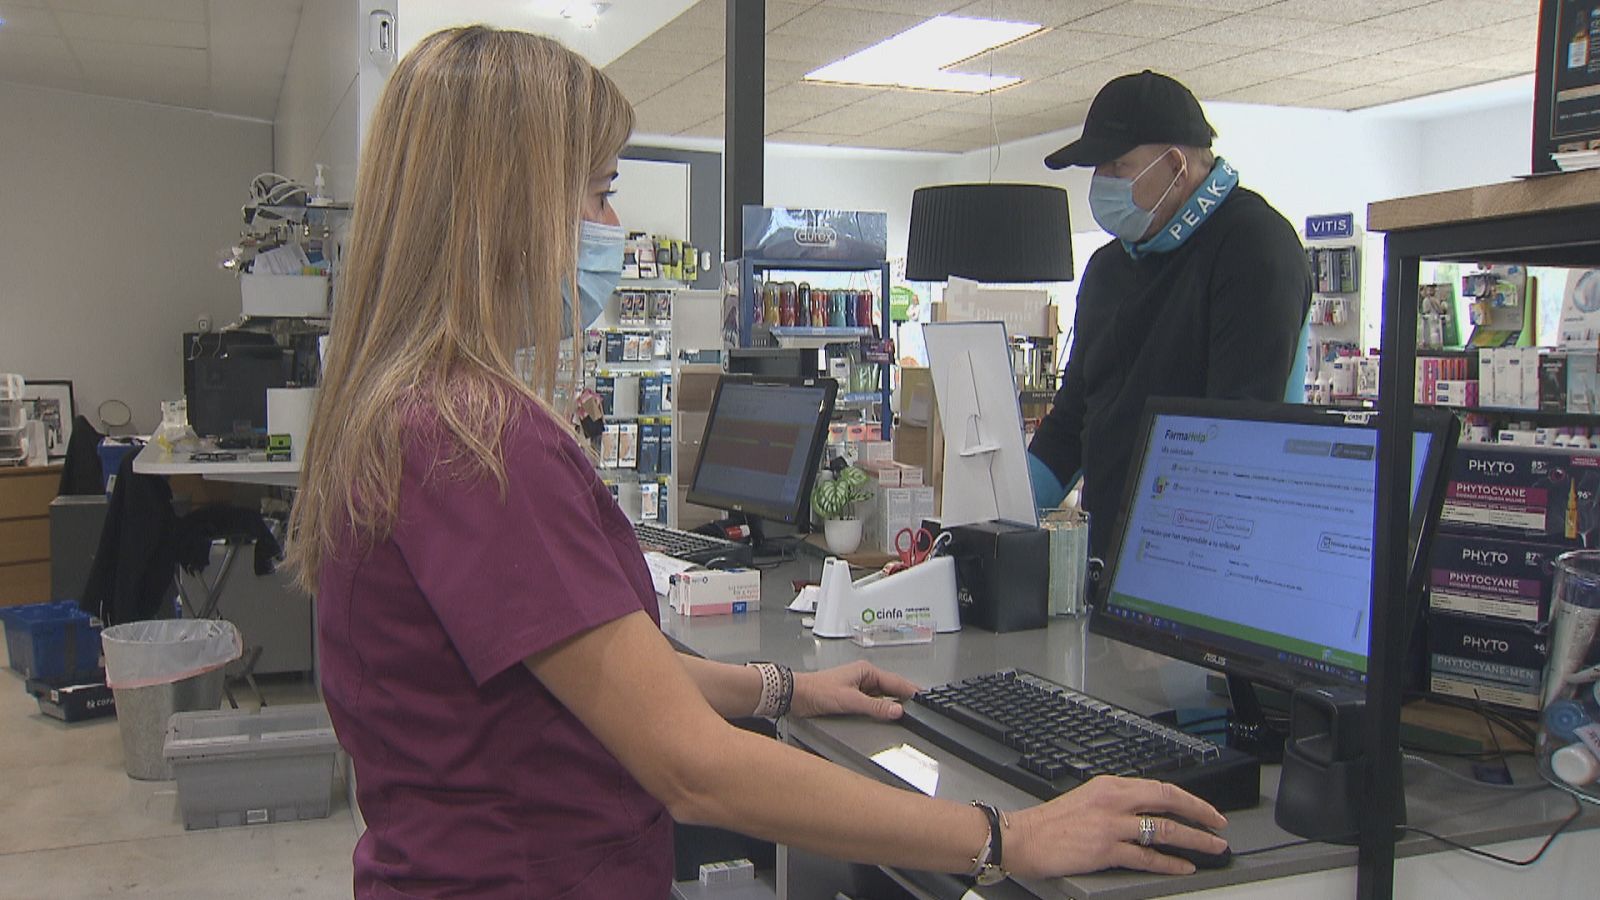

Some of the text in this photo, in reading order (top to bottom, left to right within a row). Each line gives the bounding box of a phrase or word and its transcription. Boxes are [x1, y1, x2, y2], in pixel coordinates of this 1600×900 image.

[1168, 178, 1227, 241] PEAK
[1311, 219, 1347, 232] VITIS
[798, 226, 833, 242] durex
[1468, 459, 1515, 474] PHYTO
[1456, 483, 1526, 498] PHYTOCYANE
[1462, 548, 1508, 564] PHYTO
[1449, 572, 1519, 589] PHYTOCYANE
[876, 608, 903, 619] cinfa
[1463, 635, 1509, 652] PHYTO
[1203, 652, 1226, 666] ASUS
[1437, 656, 1535, 680] PHYTOCYANE-MEN
